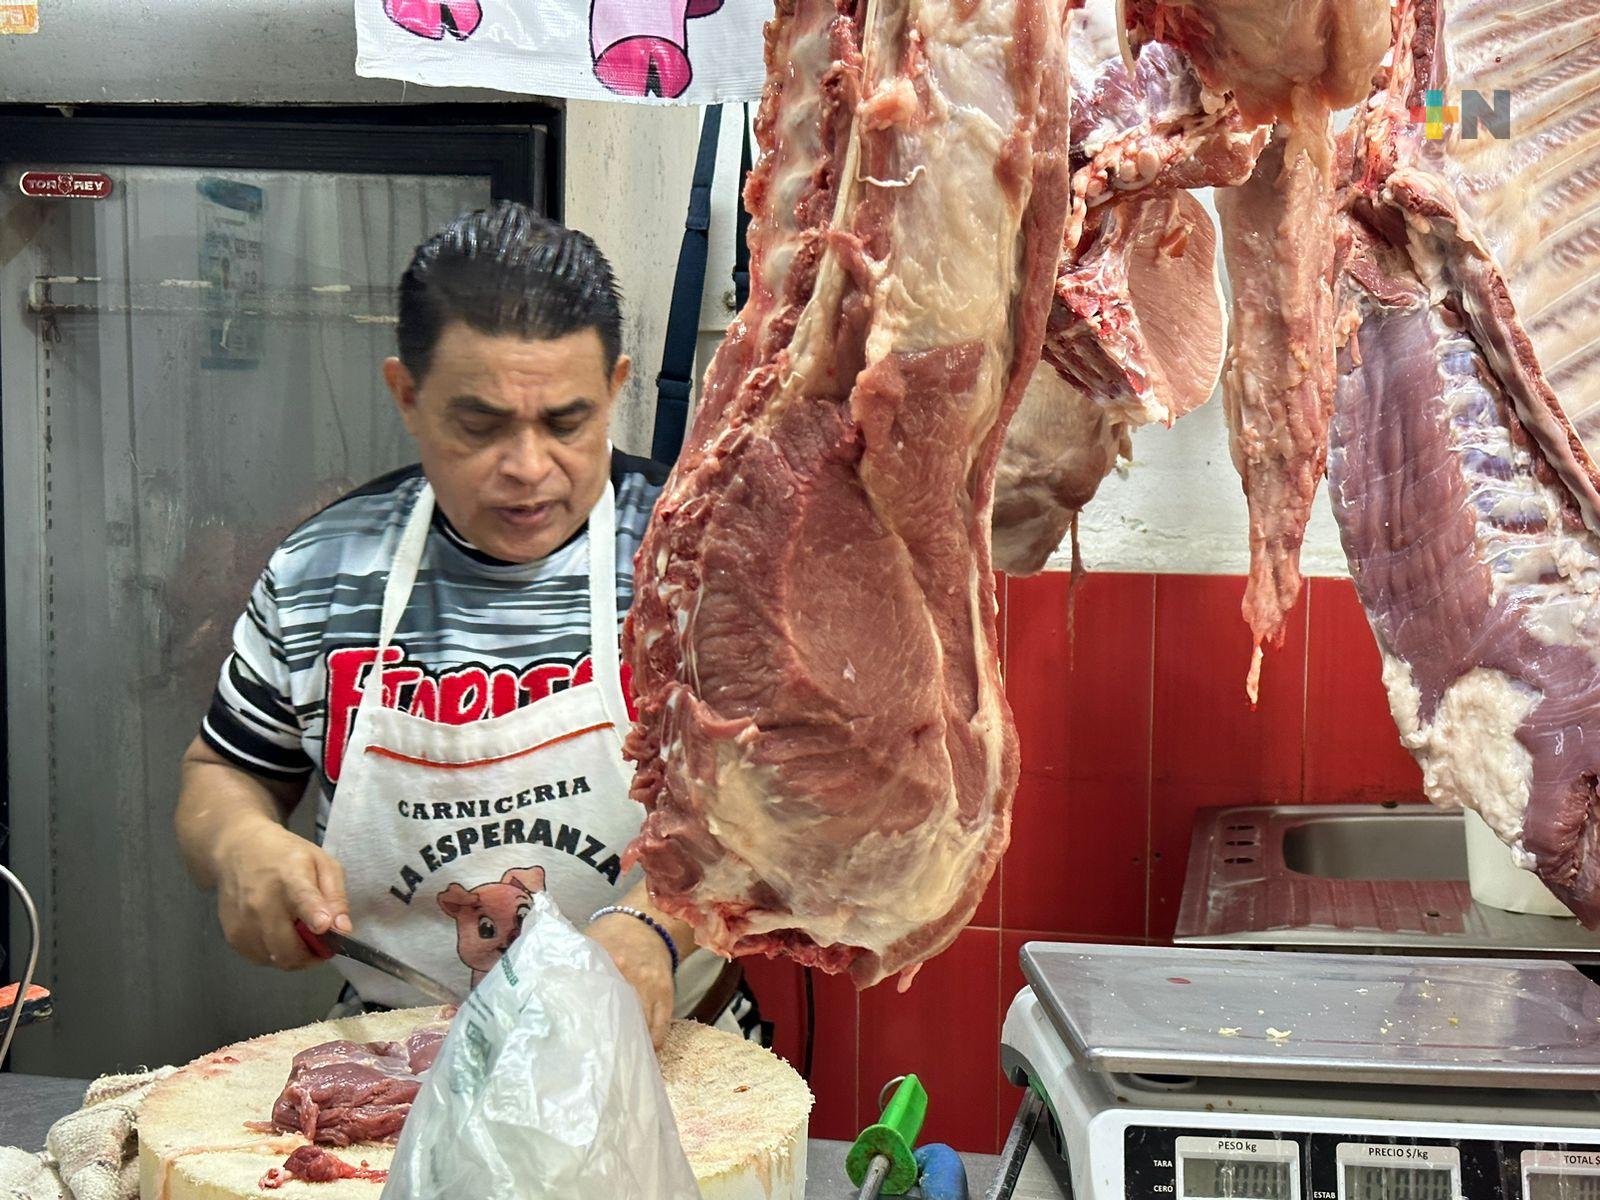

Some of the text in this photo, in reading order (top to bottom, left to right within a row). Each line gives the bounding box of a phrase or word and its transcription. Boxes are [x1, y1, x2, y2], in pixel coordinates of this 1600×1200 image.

[399, 776, 592, 820] CARNICERIA
[389, 817, 622, 906] LA ESPERANZA
[1218, 1140, 1257, 1152] PESO kg
[1368, 1147, 1429, 1160] PRECIO $/kg
[1153, 1159, 1173, 1168] TARA
[1563, 1155, 1594, 1165] TOTAL
[1153, 1185, 1174, 1193] CERO
[1313, 1190, 1336, 1199] ESTAB
